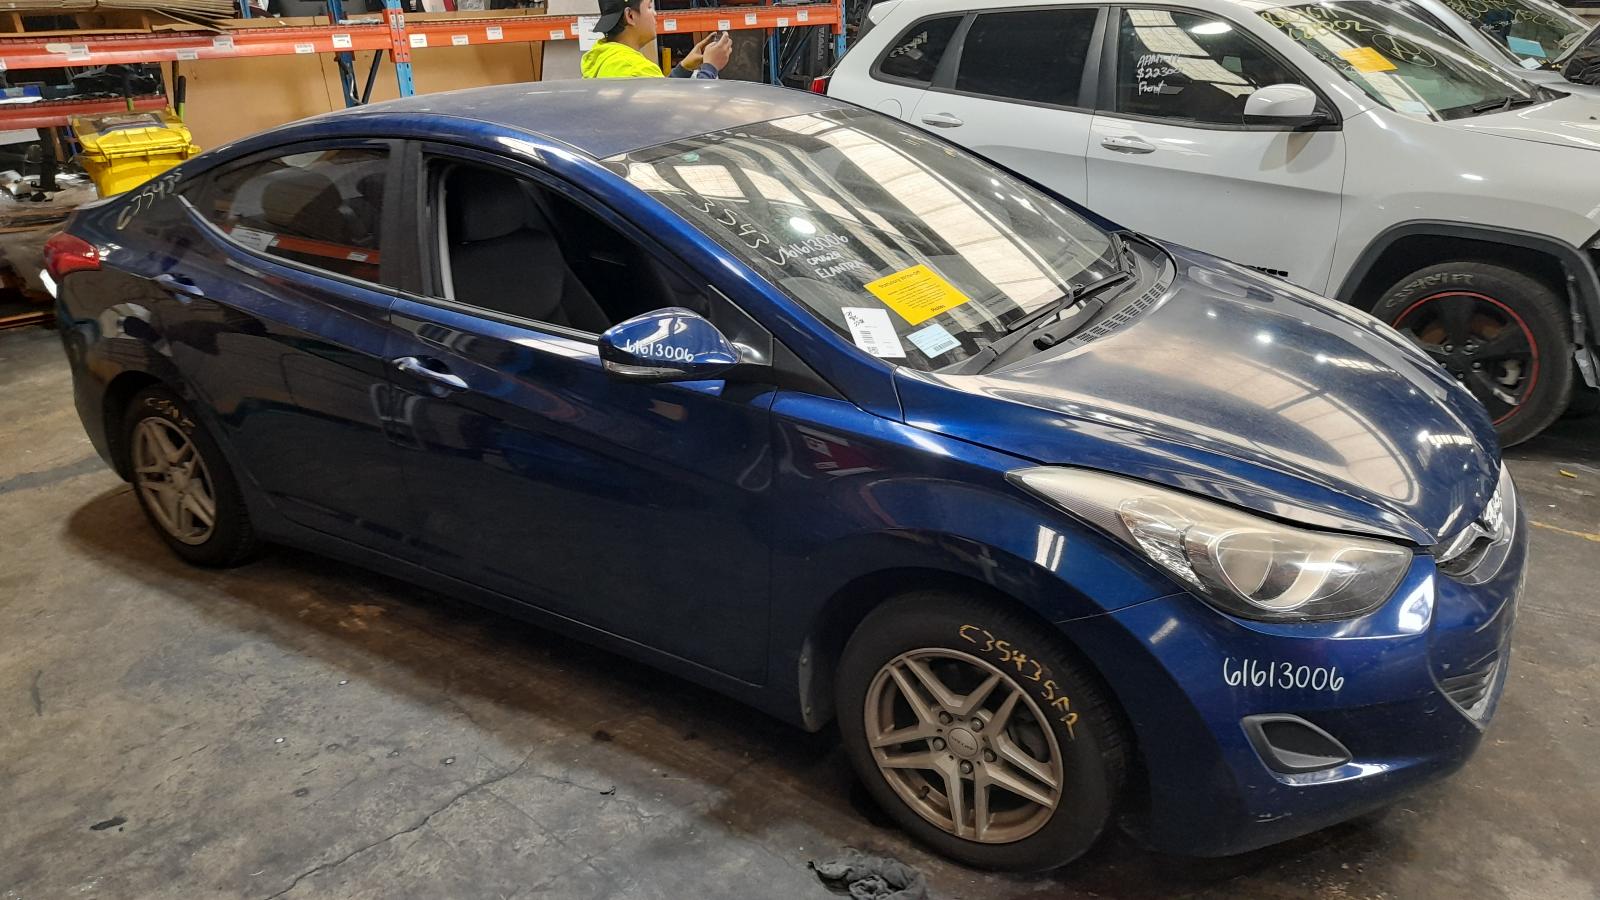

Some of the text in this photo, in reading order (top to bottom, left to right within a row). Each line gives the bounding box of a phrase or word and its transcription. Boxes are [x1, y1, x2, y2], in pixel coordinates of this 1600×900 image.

[780, 233, 849, 259] 61613006
[625, 338, 695, 362] 61613006
[1222, 656, 1345, 692] 61613006
